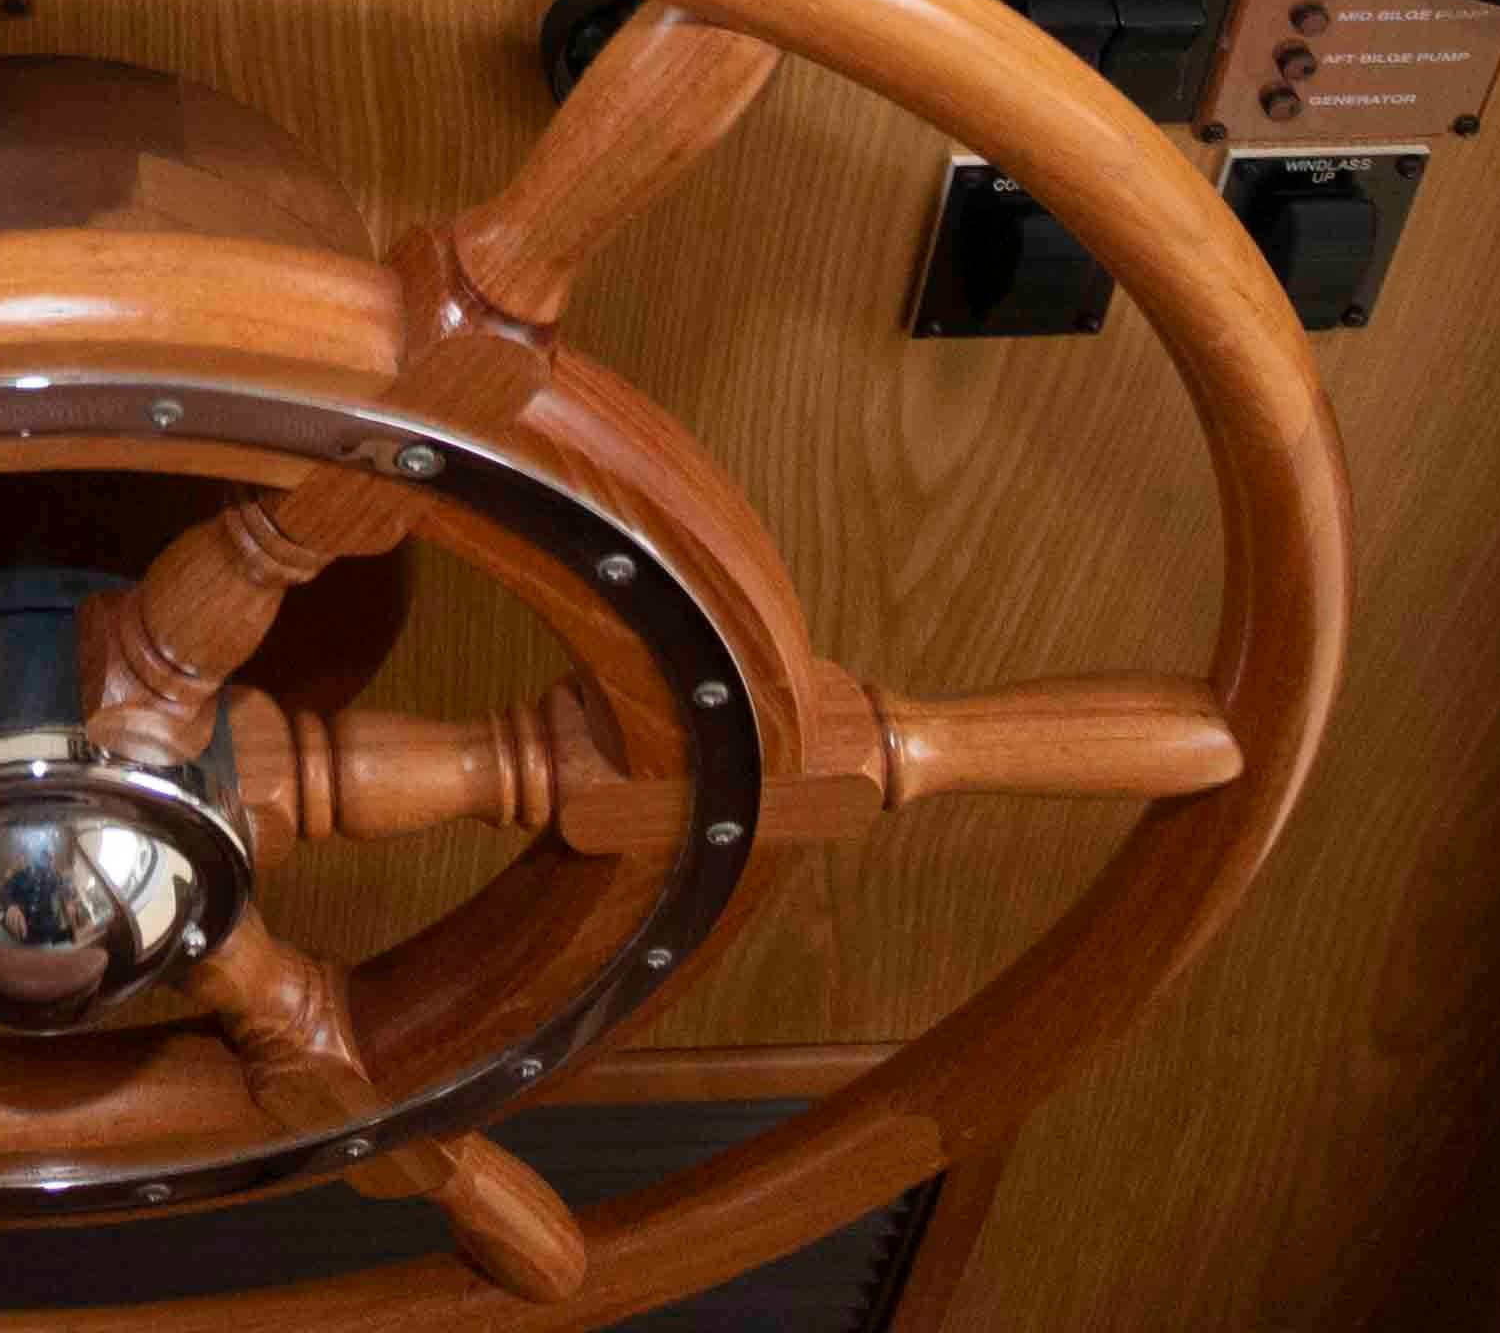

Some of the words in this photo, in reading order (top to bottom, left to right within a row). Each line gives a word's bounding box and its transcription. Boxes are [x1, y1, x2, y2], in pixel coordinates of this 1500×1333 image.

[1337, 10, 1373, 23] MID
[1376, 9, 1433, 22] BILGE
[1322, 52, 1356, 65] AFT
[1359, 52, 1414, 64] BILGE
[1416, 51, 1472, 63] PUMP
[1309, 93, 1418, 108] GENERATOR
[1285, 157, 1372, 173] WINDLASS
[1311, 170, 1336, 185] UP
